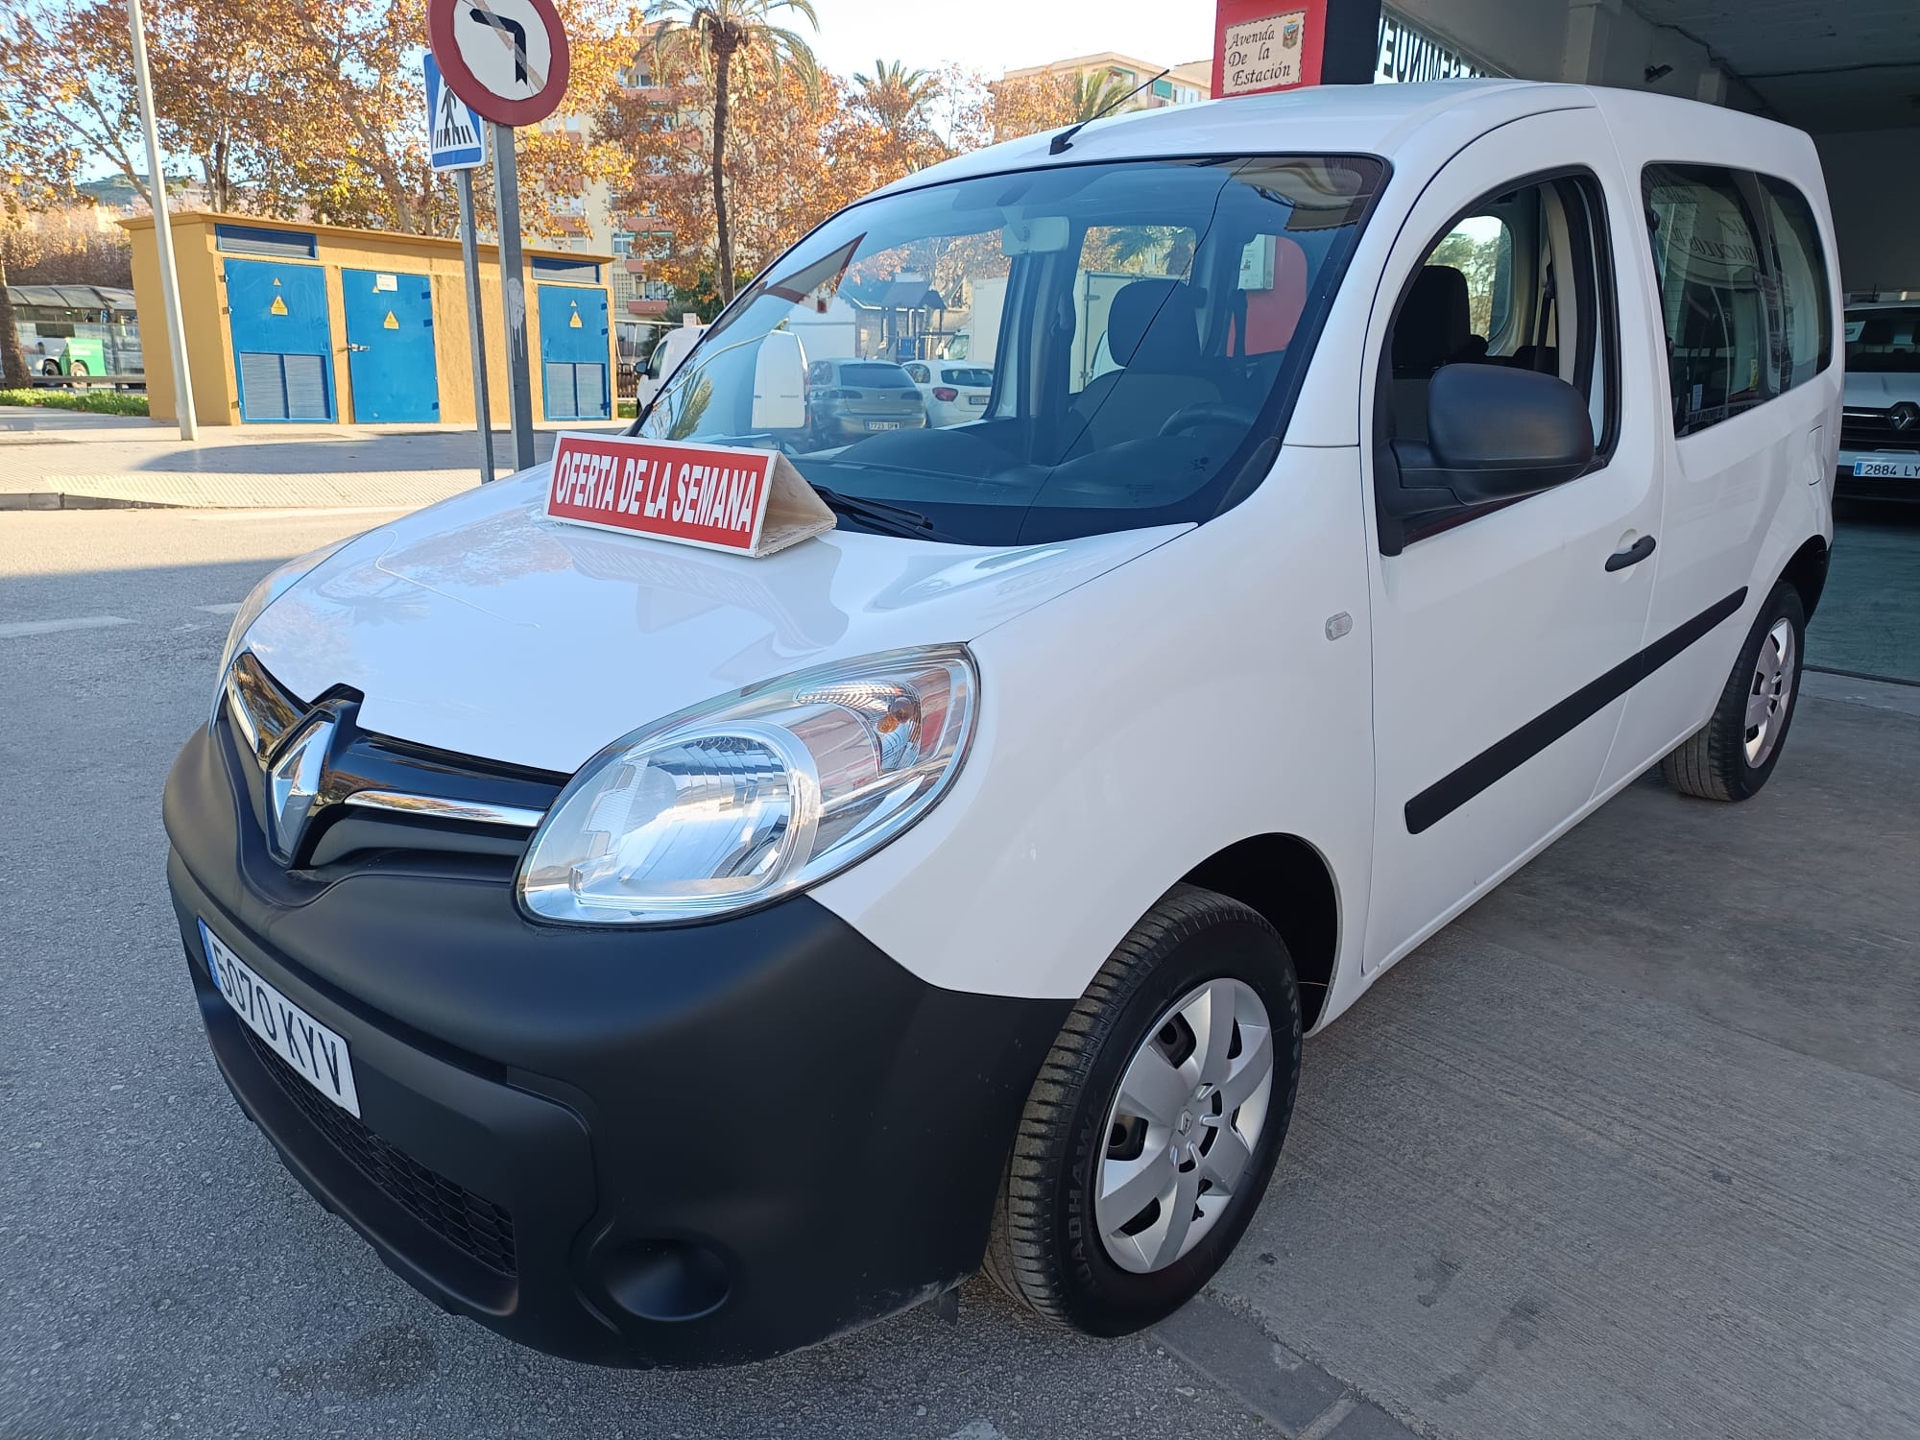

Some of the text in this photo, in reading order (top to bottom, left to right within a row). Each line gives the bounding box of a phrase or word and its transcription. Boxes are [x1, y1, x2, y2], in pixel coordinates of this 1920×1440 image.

[1228, 24, 1275, 50] Avenida
[1228, 42, 1270, 67] De la
[1232, 61, 1291, 86] Estación
[1865, 464, 1897, 476] 2884
[555, 450, 758, 533] OFERTA DE LA SEMANA
[211, 941, 341, 1096] 5070 KYV
